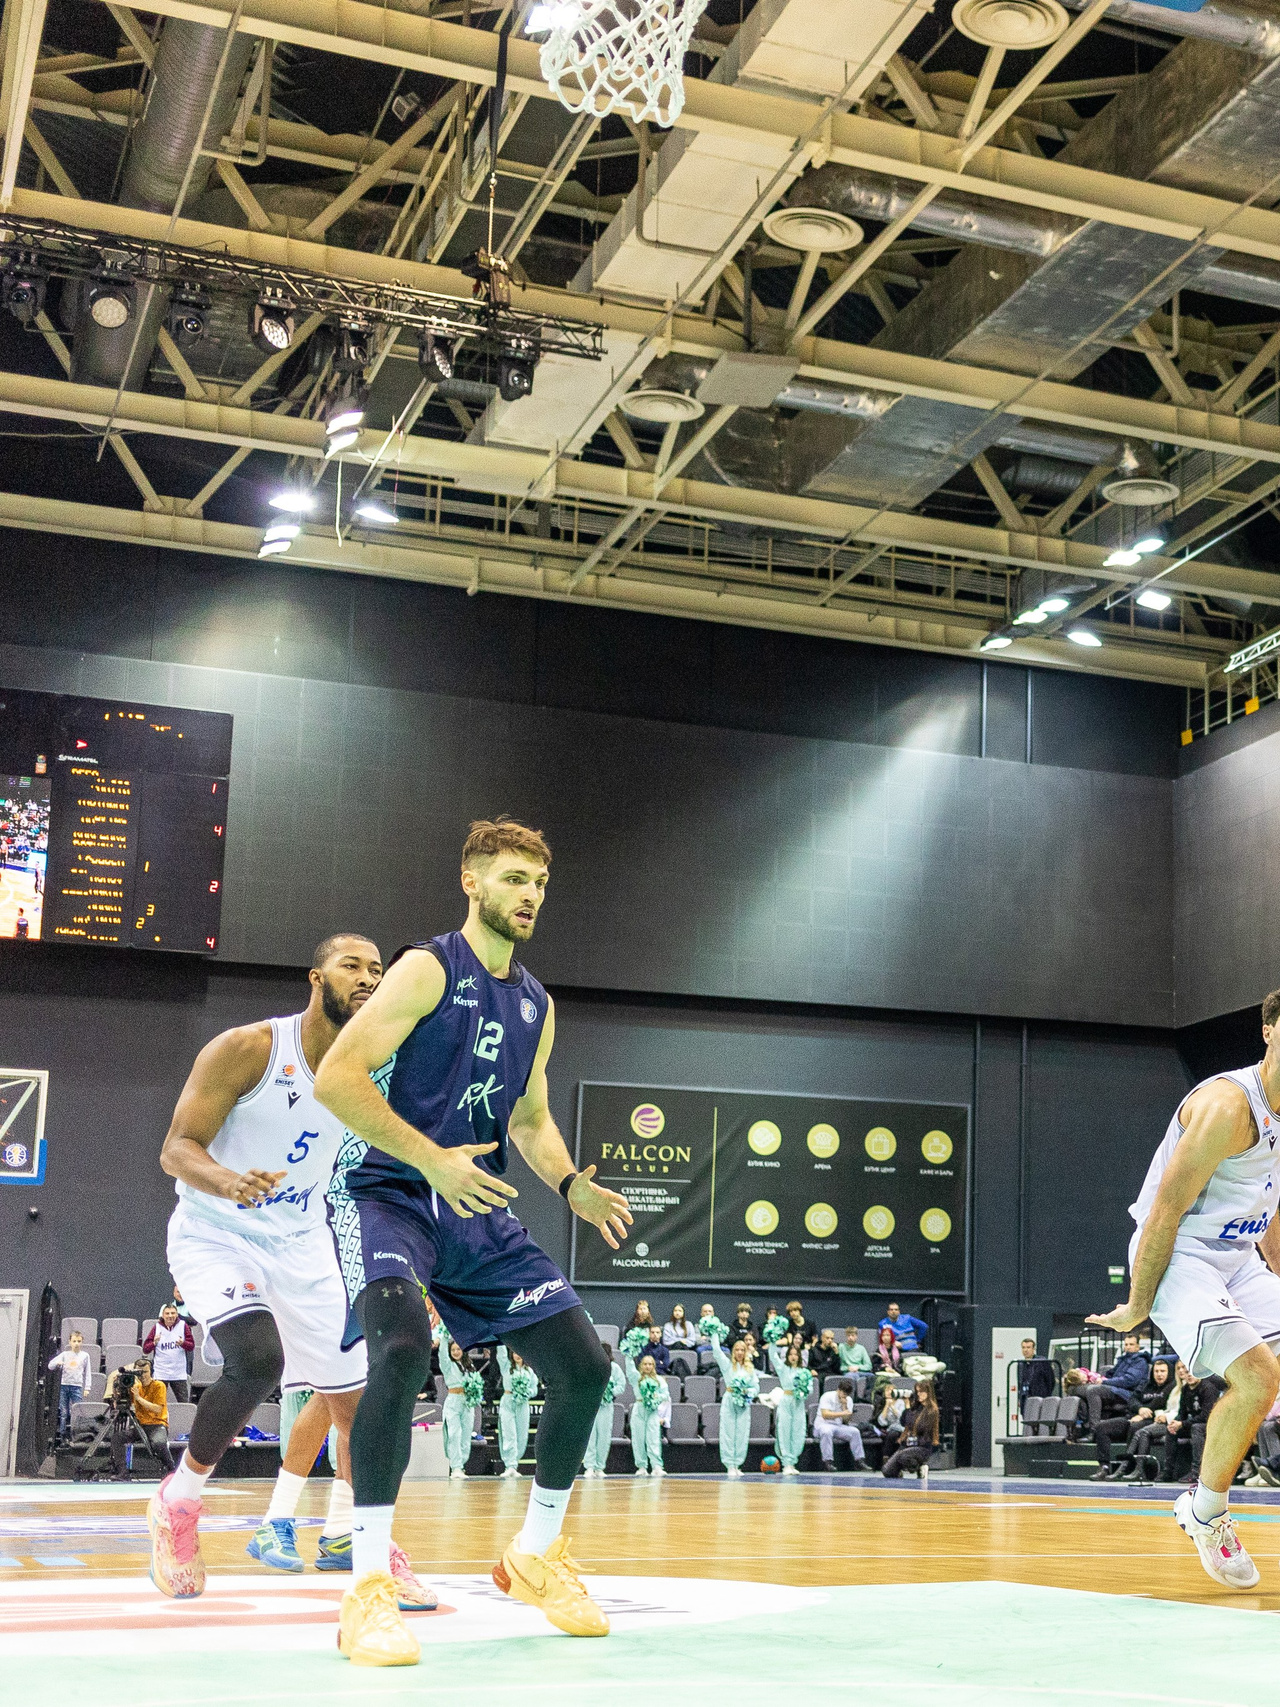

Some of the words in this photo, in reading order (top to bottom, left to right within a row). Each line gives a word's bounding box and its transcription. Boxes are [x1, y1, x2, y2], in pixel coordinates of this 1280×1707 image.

[211, 782, 218, 795] 1
[214, 825, 223, 837] 4
[144, 861, 150, 873] 1
[209, 880, 219, 893] 2
[146, 904, 155, 916] 3
[135, 917, 145, 929] 2
[206, 937, 215, 949] 4
[473, 1015, 504, 1062] 12
[287, 1130, 320, 1164] 5
[601, 1143, 691, 1163] FALCON
[623, 1164, 669, 1173] CLUB
[628, 1203, 666, 1212] ОМПЛЕКС
[1218, 1211, 1269, 1239] Enis
[612, 1258, 671, 1268] FALCONCLUB.BY
